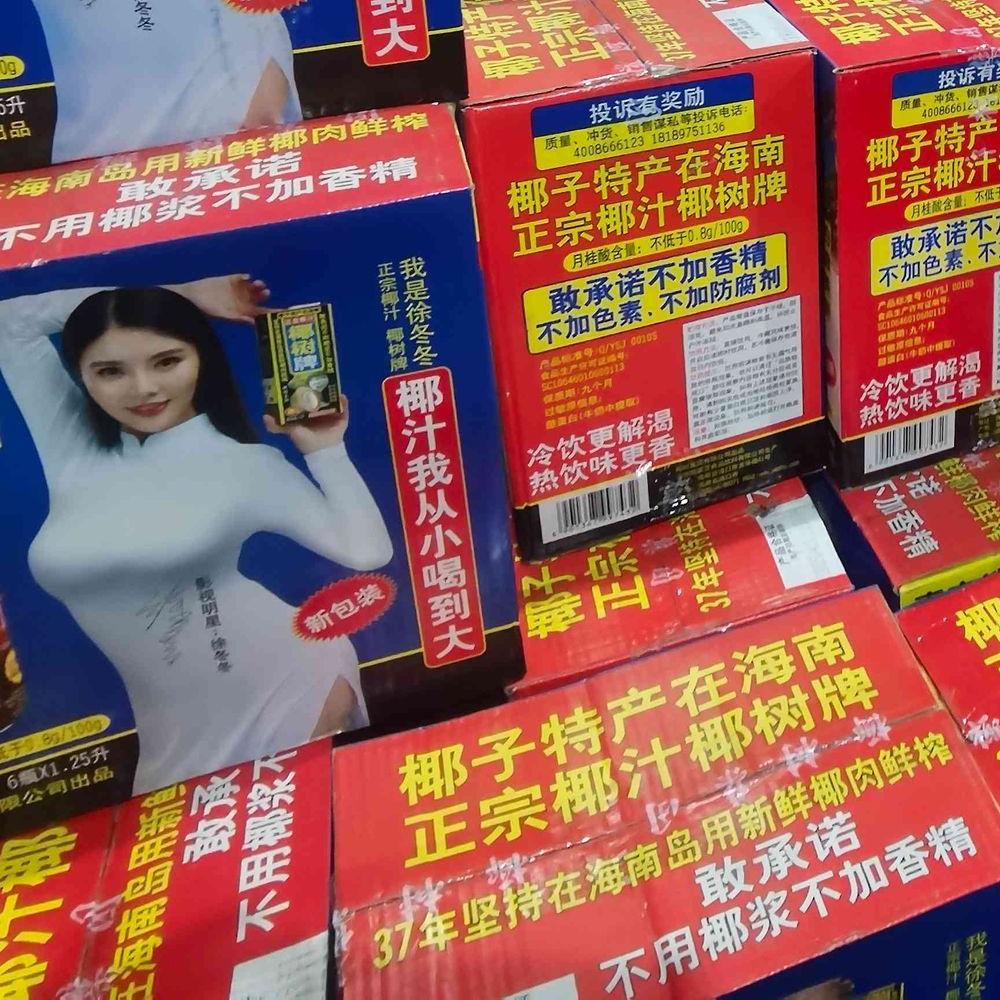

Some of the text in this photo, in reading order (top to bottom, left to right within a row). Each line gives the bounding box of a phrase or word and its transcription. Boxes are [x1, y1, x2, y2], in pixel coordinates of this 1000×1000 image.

[574, 122, 726, 160] 4008666123 18189751136
[590, 86, 706, 126] 投诉有奖励
[117, 154, 303, 204] 敢承诺
[506, 133, 786, 218] 椰子特产在海南
[513, 172, 788, 258] 正宗椰汁椰树牌
[399, 256, 439, 368] 我是徐冬冬
[549, 240, 768, 314] 敢承诺不加香精
[859, 352, 981, 401] 冷饮更解渴
[859, 377, 981, 428] 热饮味更香
[526, 406, 674, 468] 冷饮更解渴
[529, 434, 676, 497] 热饮味更香
[396, 378, 476, 660] 椰汁我从小喝到大
[303, 583, 386, 635] 新包装
[397, 621, 858, 805] 椰子特产在海南
[403, 668, 880, 870] 正宗椰汁椰树牌
[371, 731, 956, 971] 37年坚持在海南岛用新鲜椰肉鲜榨
[694, 813, 864, 909] 敢承诺
[599, 817, 980, 1000] 不用椰浆不加香精
